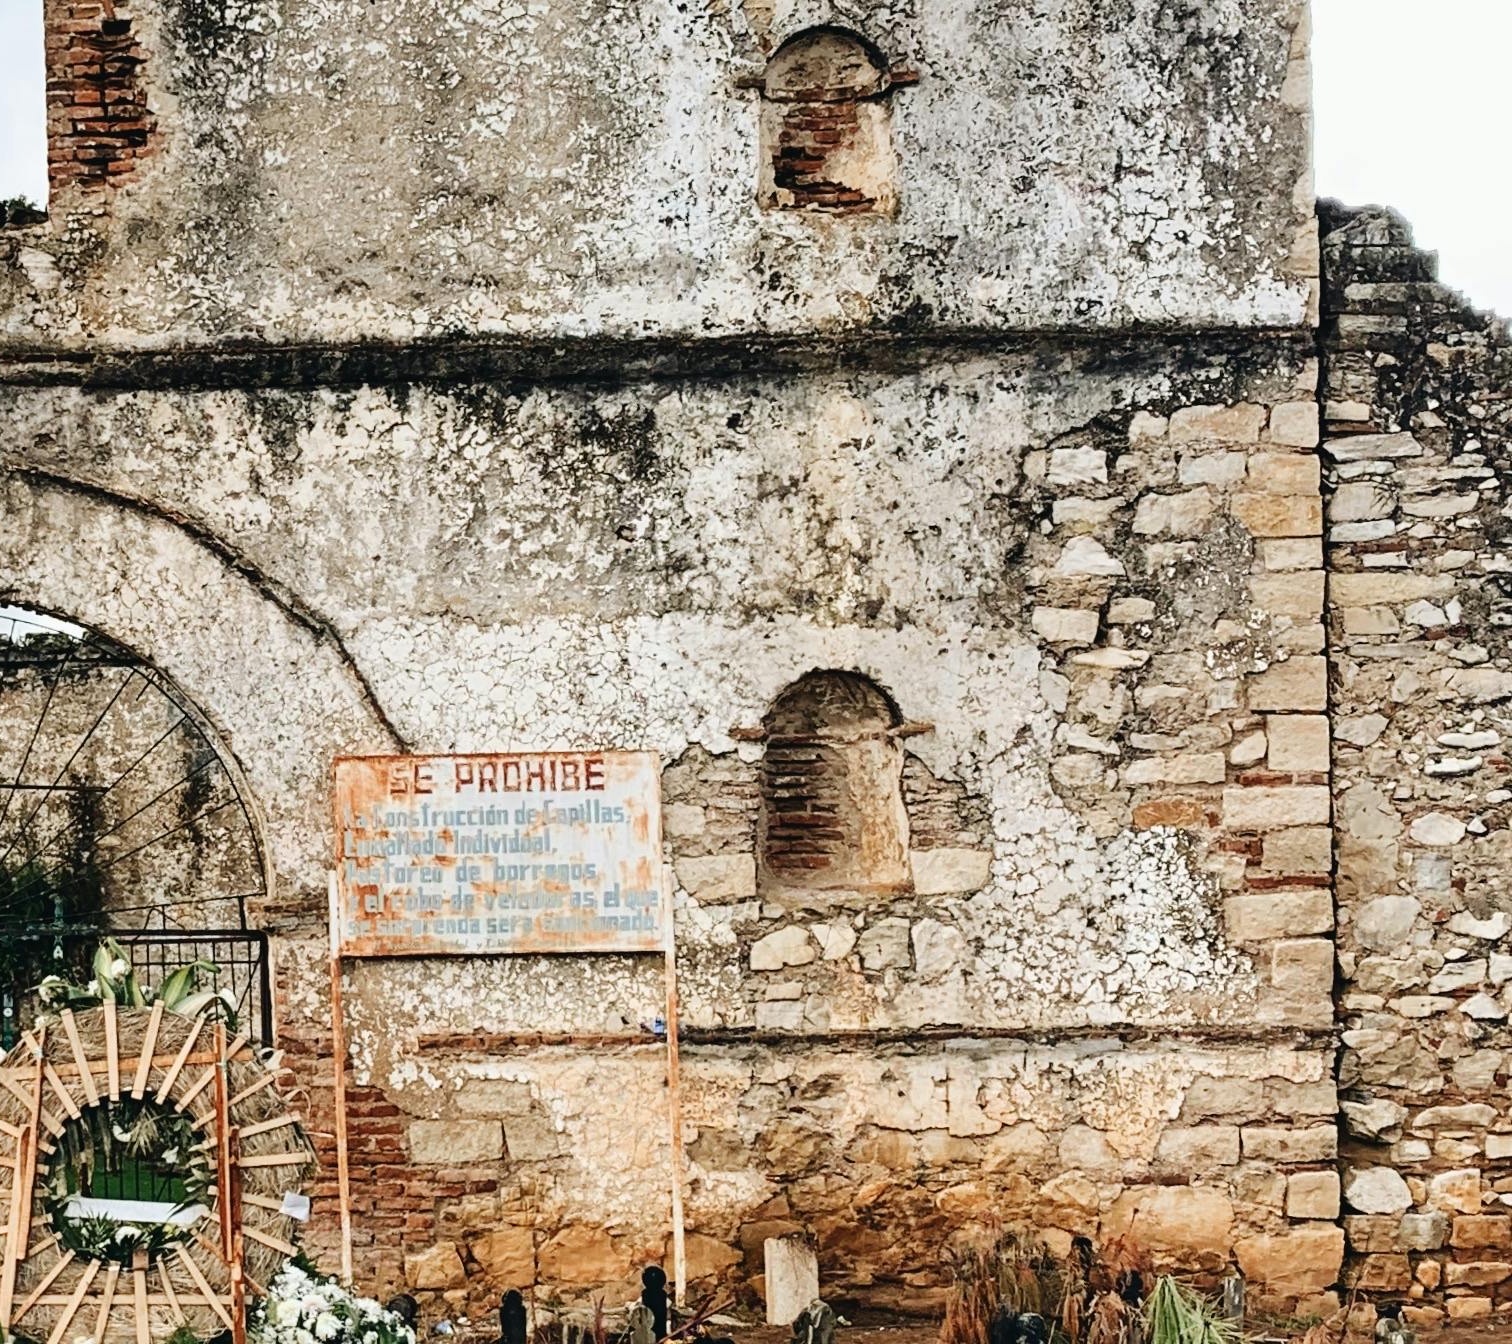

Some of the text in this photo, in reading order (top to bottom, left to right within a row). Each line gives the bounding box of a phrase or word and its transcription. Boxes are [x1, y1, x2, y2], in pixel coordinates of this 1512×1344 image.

[390, 758, 605, 795] SE PROHIBE
[514, 799, 537, 825] de
[455, 857, 481, 883] de
[494, 856, 597, 884] borregos
[451, 884, 474, 910] de
[603, 882, 621, 908] el
